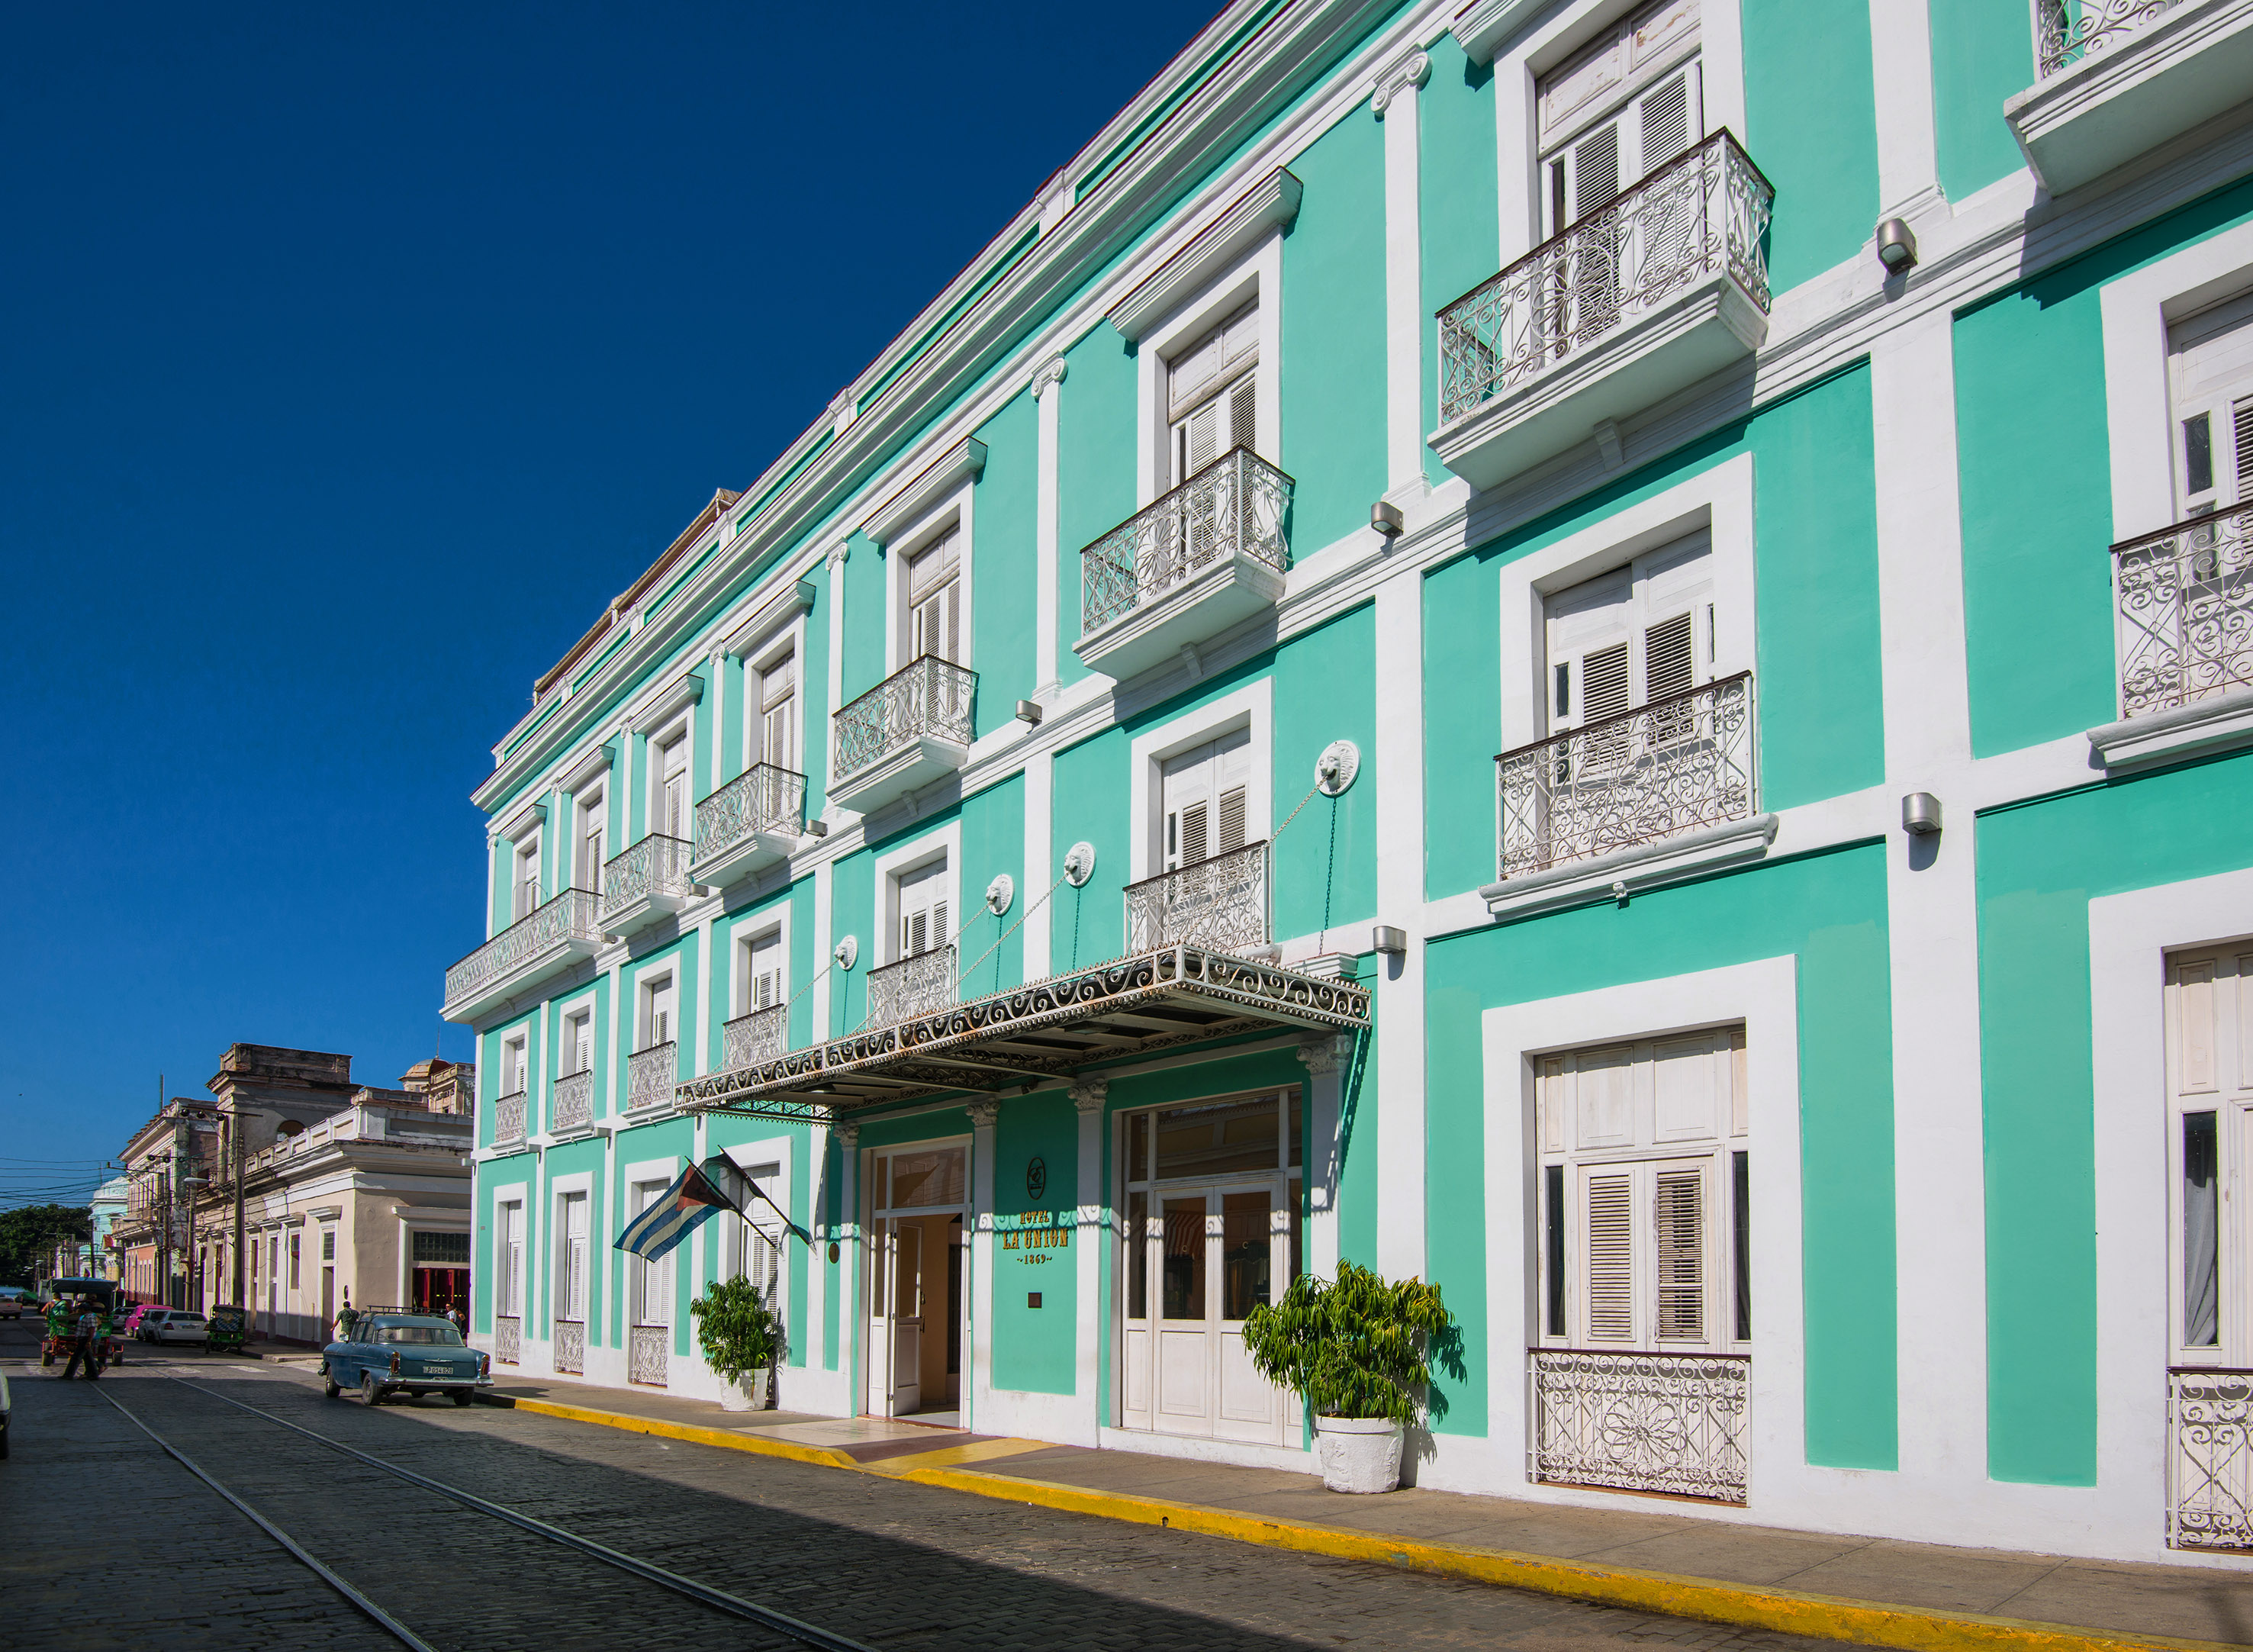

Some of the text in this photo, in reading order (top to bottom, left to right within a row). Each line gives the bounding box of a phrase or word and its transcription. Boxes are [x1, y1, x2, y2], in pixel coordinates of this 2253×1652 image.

[1019, 1210, 1050, 1225] HOTEL
[1003, 1227, 1068, 1250] LA UNION
